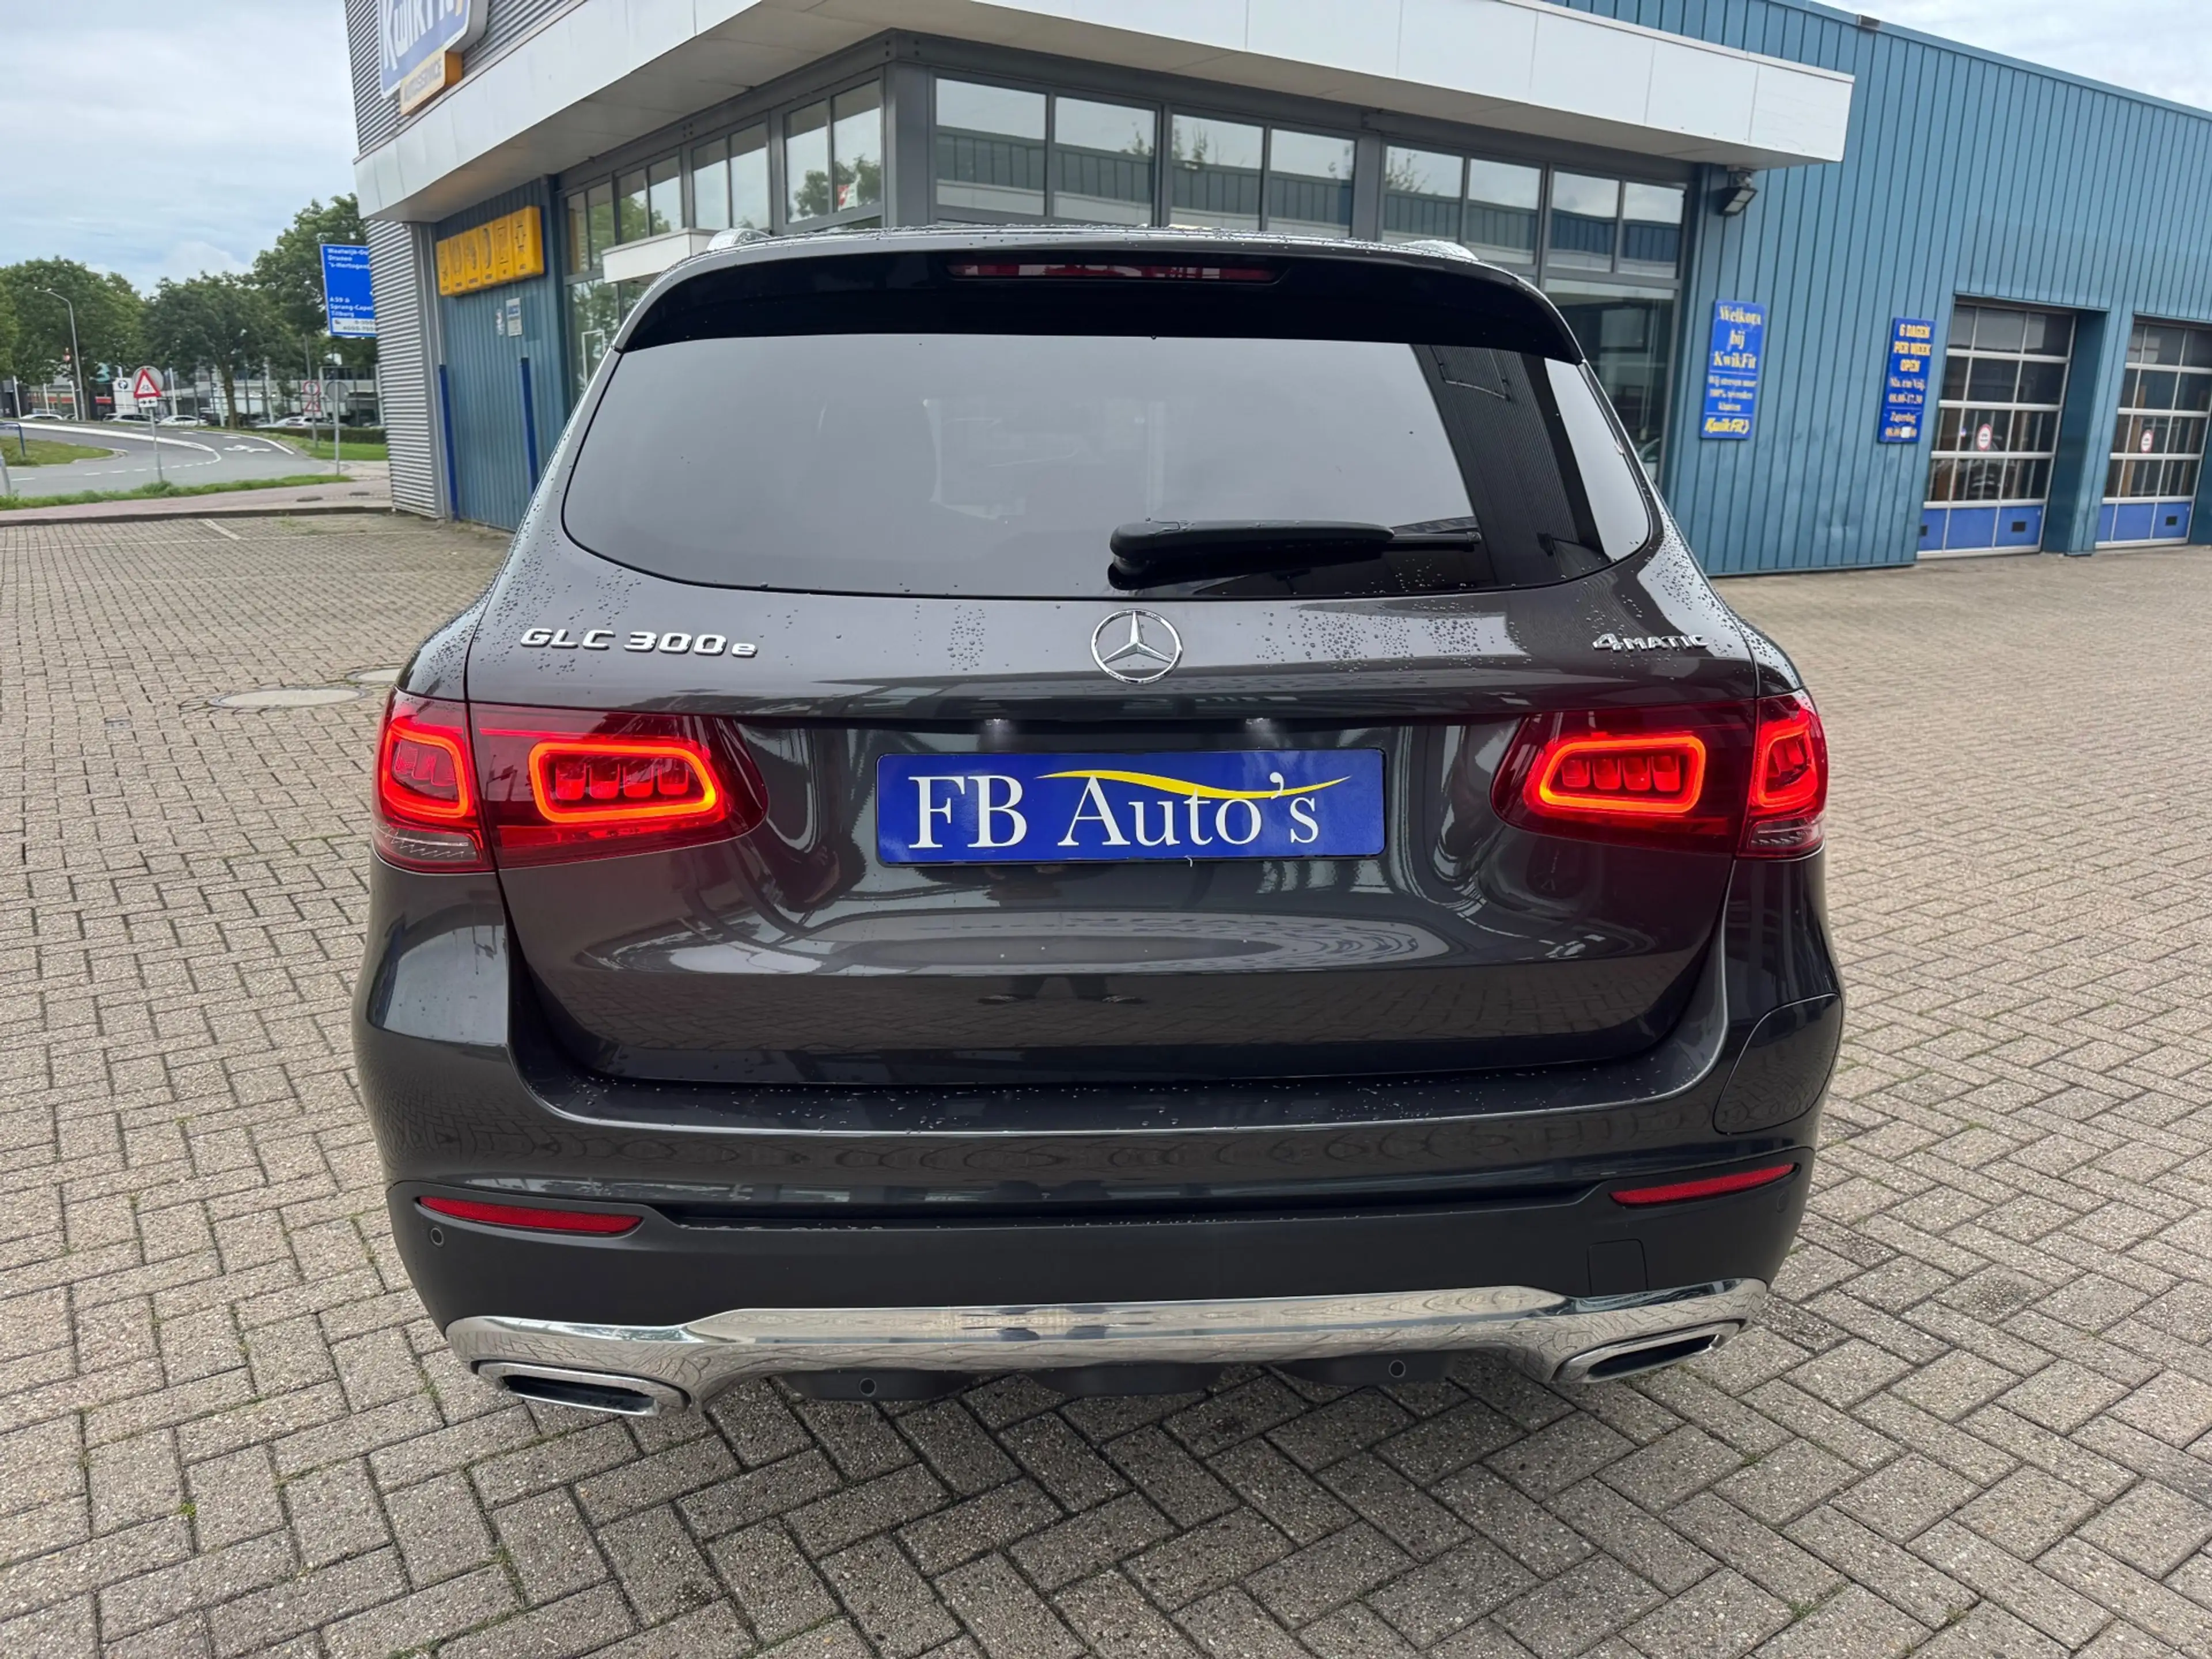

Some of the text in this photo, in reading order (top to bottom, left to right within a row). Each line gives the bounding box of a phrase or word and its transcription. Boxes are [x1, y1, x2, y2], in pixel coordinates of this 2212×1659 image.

[1719, 306, 1761, 325] Welkom
[1730, 329, 1745, 350] bij
[1894, 341, 1931, 356] PER WEEK
[1900, 359, 1921, 373] OPEN
[520, 628, 615, 650] GLC
[1592, 634, 1709, 652] 4MATIC
[908, 772, 1319, 849] FB Auto's
